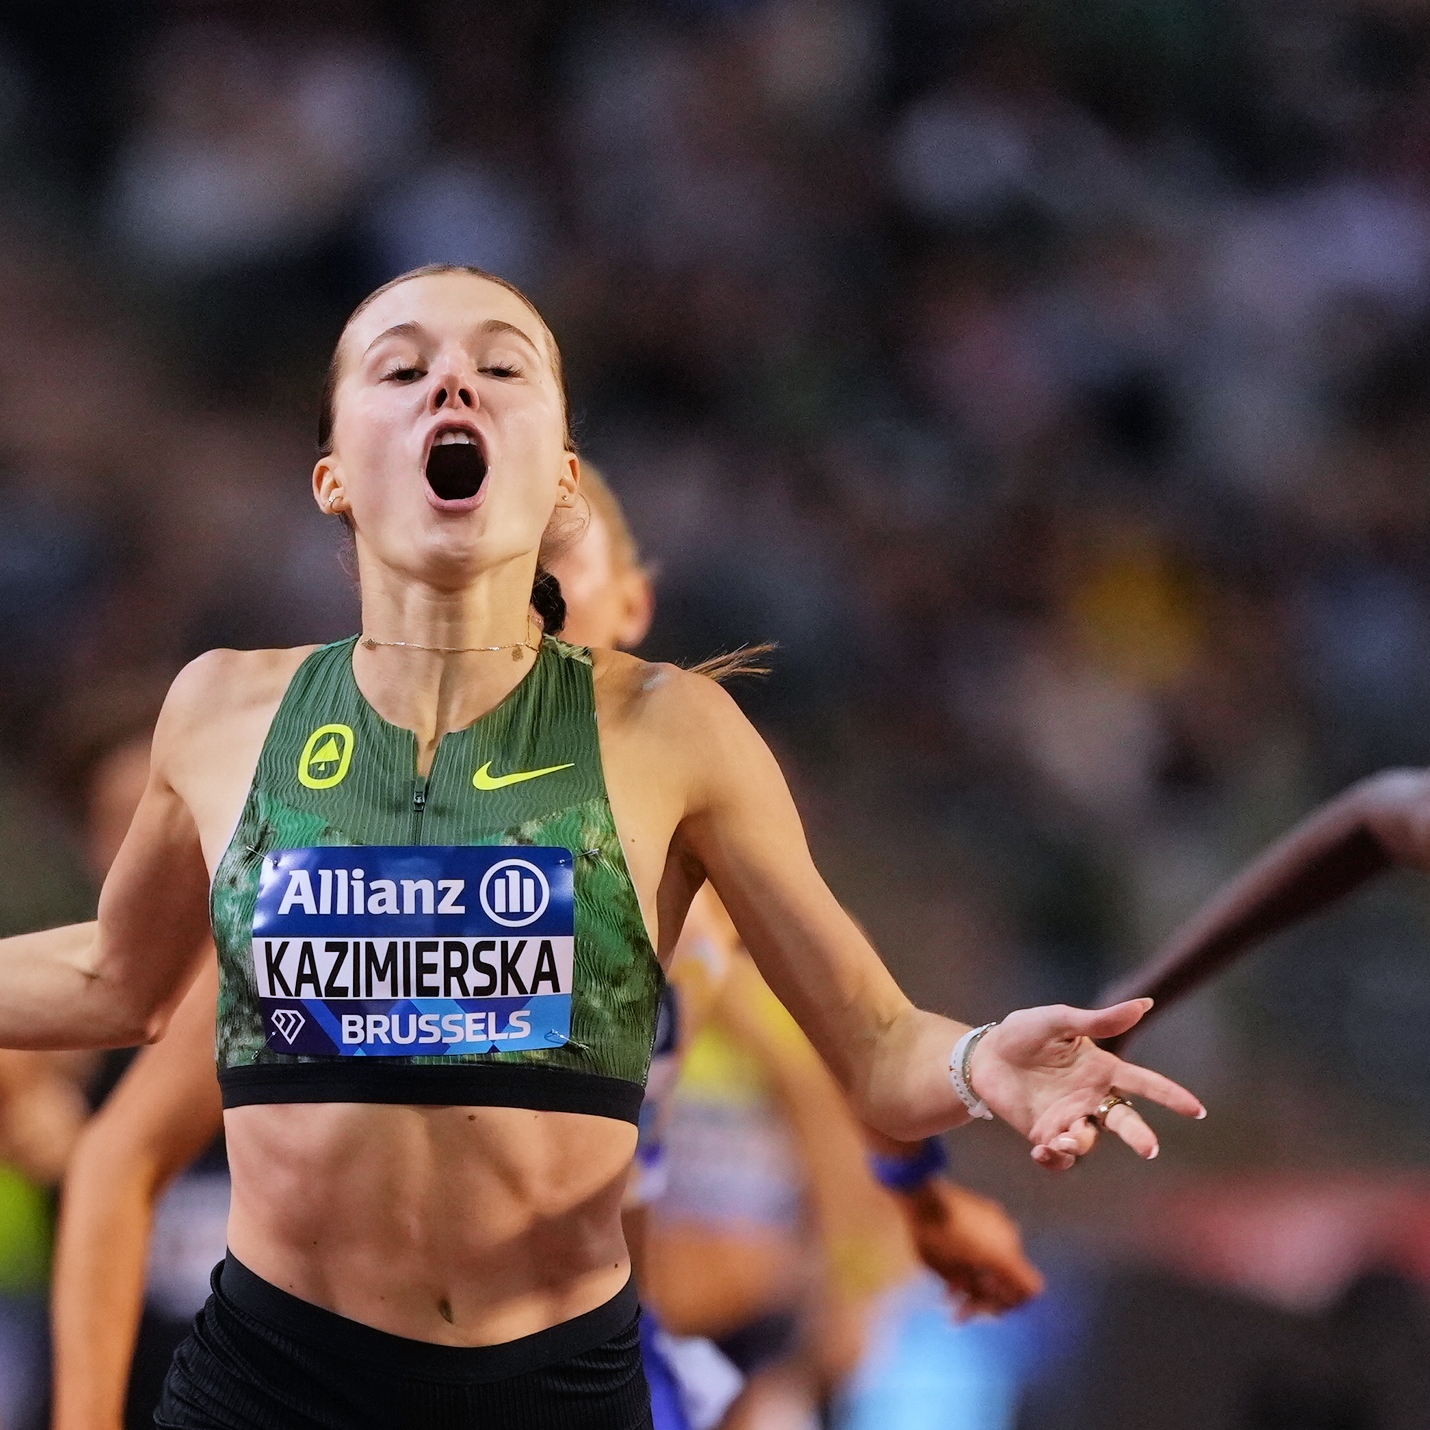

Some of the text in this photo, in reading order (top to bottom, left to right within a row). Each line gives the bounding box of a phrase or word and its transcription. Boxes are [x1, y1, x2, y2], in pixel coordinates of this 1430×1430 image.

[277, 869, 465, 915] Allianz
[264, 939, 561, 999] KAZIMIERSKA
[341, 1010, 531, 1045] BRUSSELS
